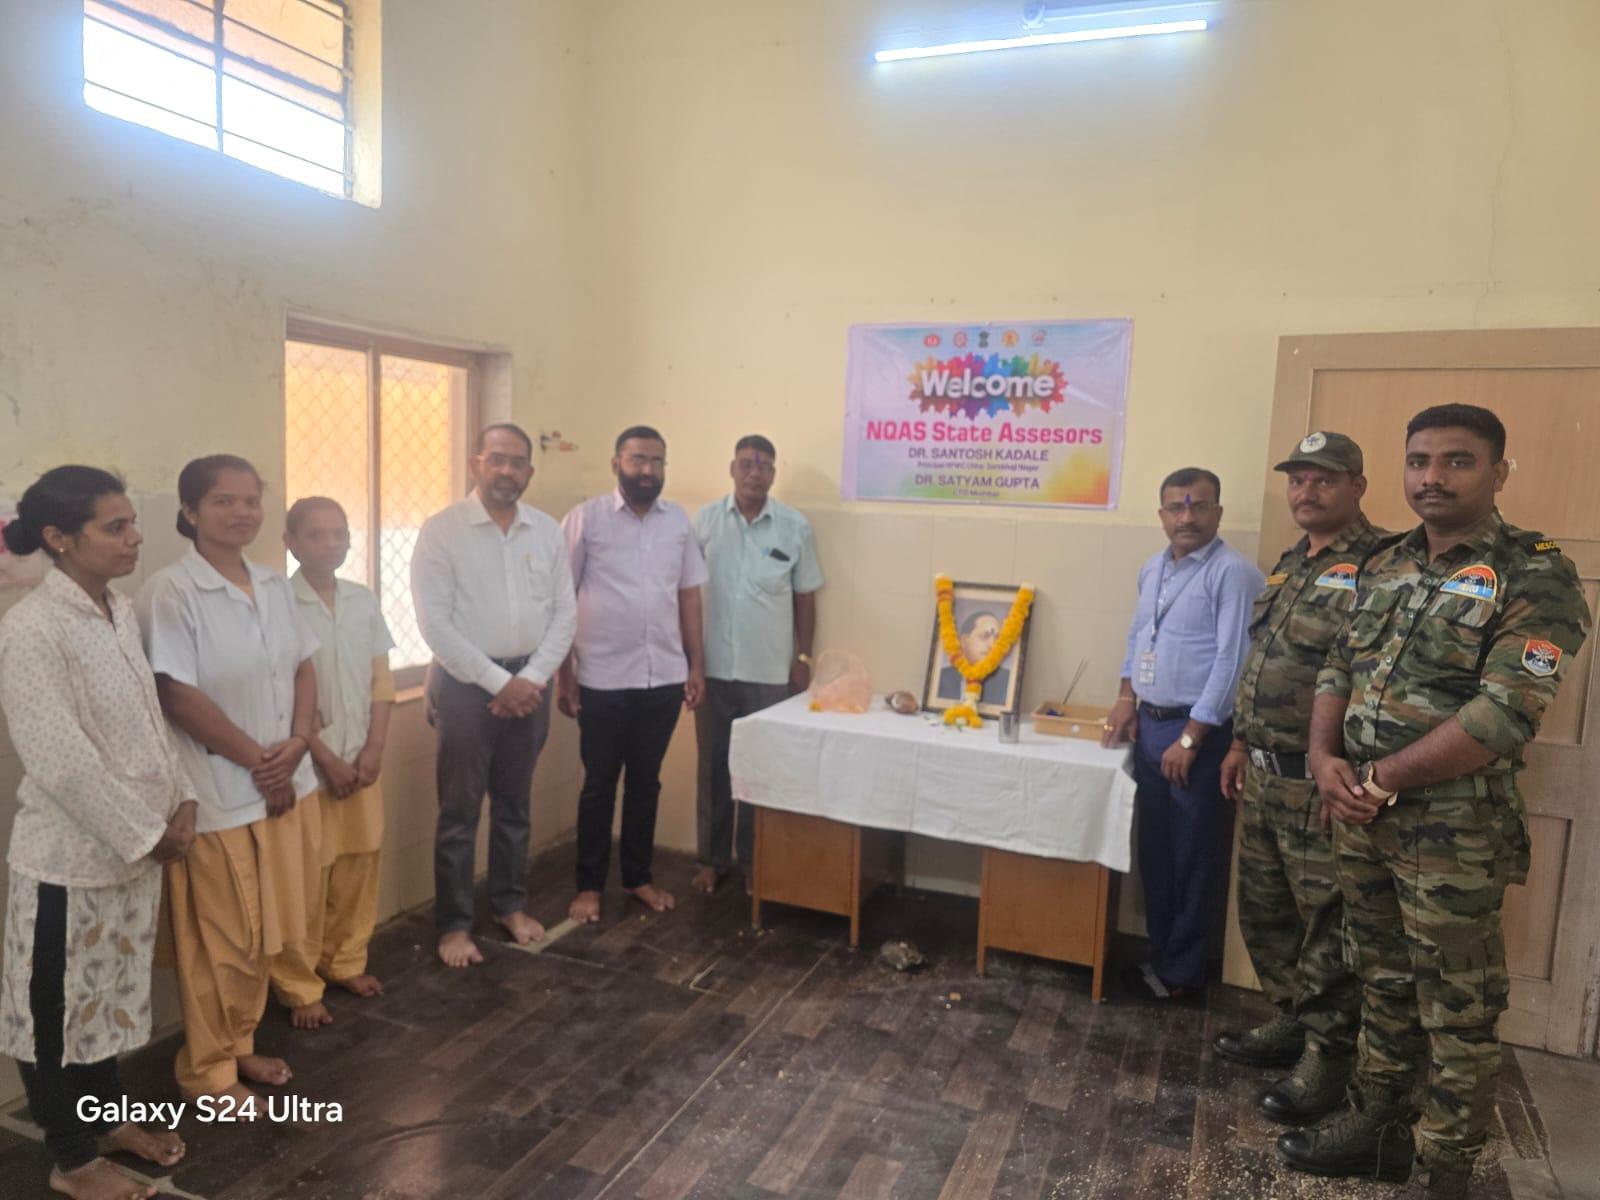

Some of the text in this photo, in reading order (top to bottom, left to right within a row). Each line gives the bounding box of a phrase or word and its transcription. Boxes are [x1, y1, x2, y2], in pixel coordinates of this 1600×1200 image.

[920, 368, 1055, 397] Welcome
[866, 421, 1103, 445] NQAS State Assesors
[908, 447, 1049, 461] DR. SANTOSH KADALE
[938, 475, 992, 487] SATYAM
[995, 477, 1040, 489] GUPTA
